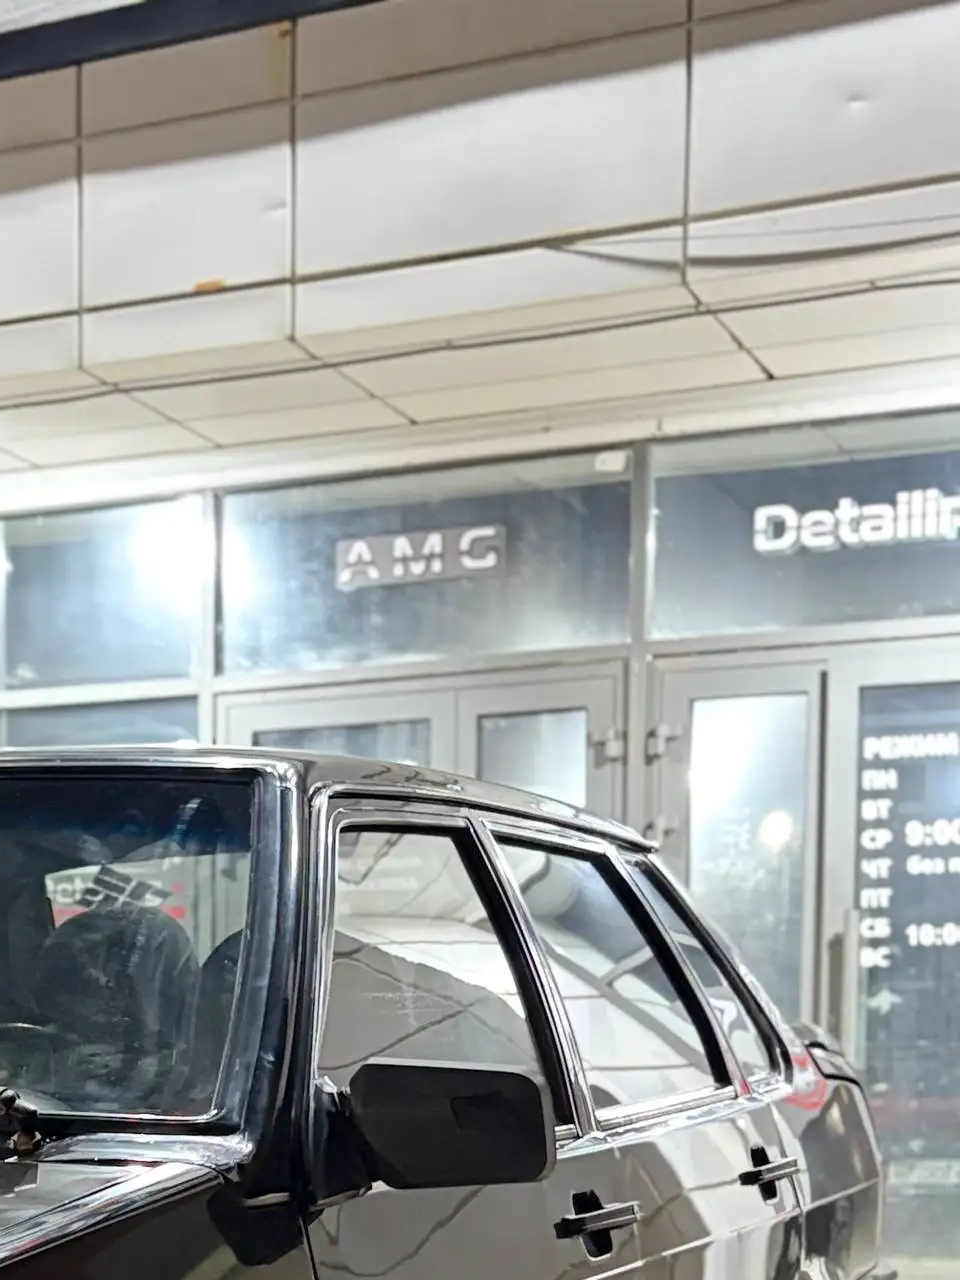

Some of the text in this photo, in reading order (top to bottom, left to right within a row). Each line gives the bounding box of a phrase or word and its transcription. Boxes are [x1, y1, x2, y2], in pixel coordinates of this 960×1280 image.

[339, 525, 497, 583] AMG
[863, 732, 959, 760] РЕЖИМ
[861, 768, 898, 791] ПН
[860, 798, 893, 821] ВТ
[860, 828, 893, 850] СР
[860, 857, 893, 879] ЧТ
[859, 887, 893, 909] ПТ
[859, 917, 960, 947] СБ 10:0
